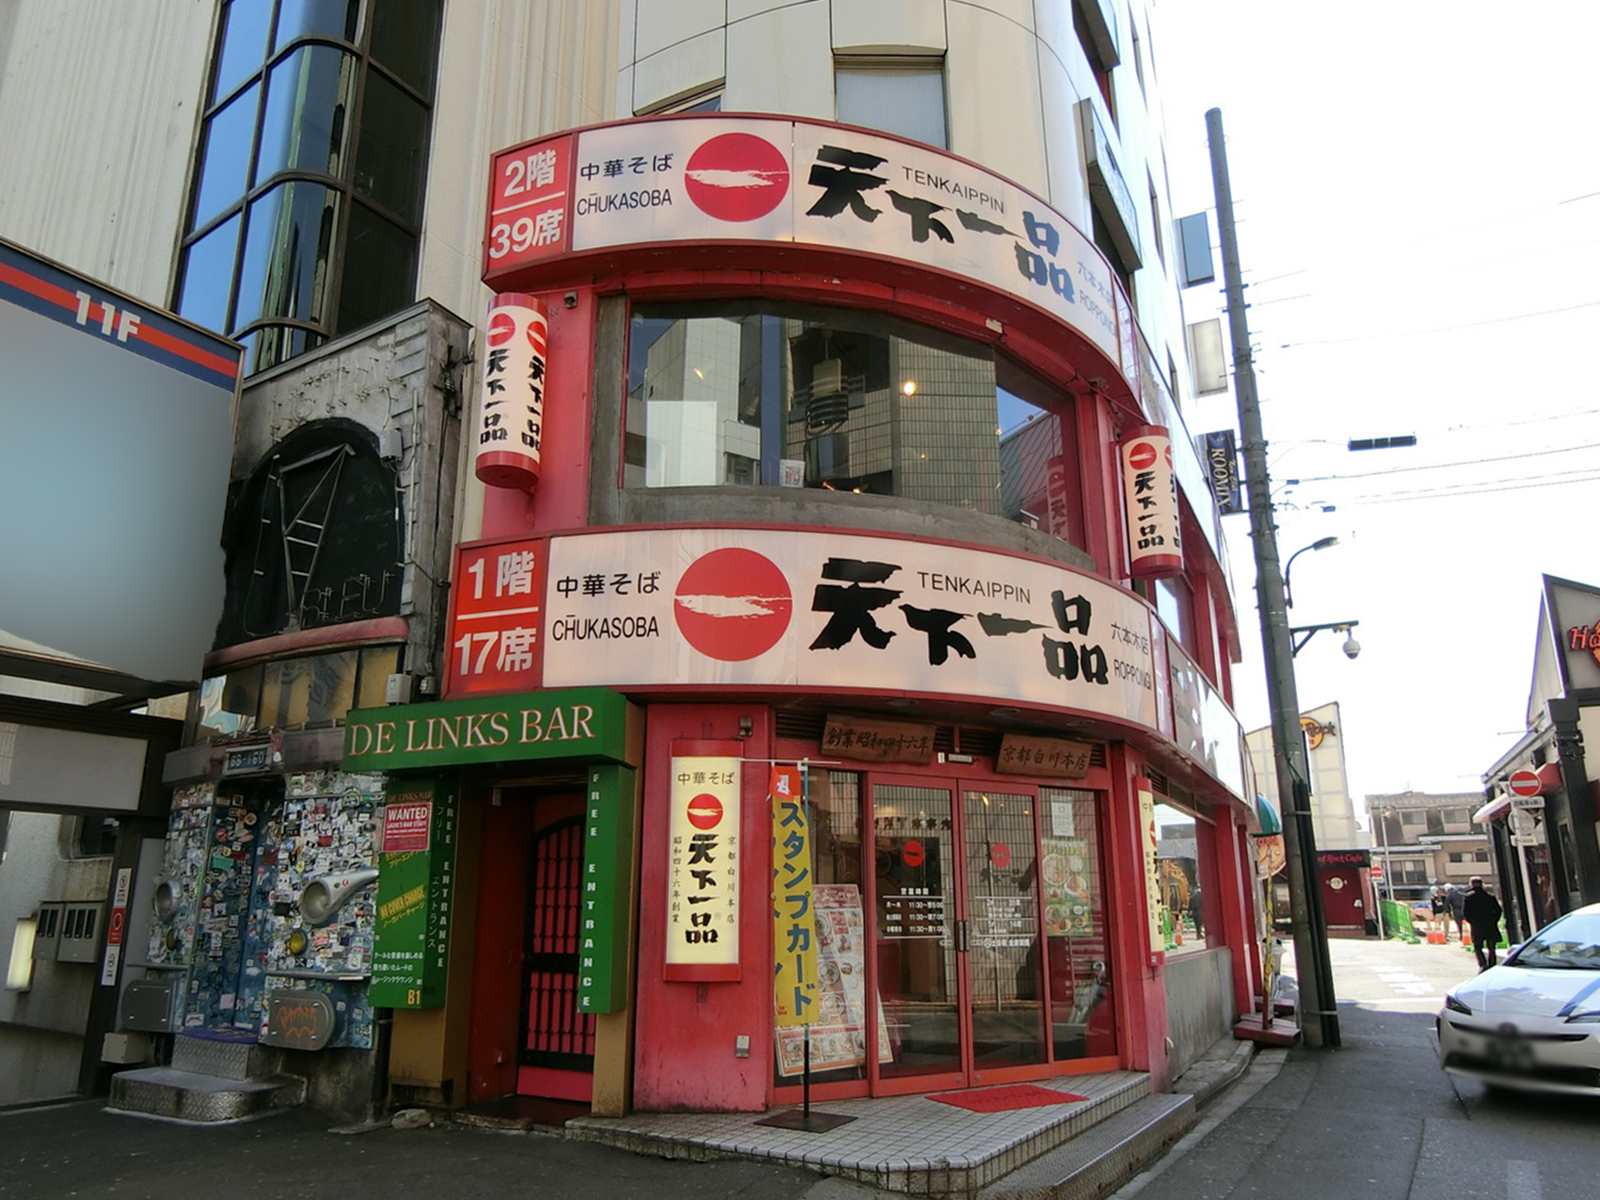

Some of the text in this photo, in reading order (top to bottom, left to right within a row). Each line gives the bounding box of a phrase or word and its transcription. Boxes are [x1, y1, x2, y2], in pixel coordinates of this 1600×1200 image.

[503, 149, 557, 198] 2階
[580, 153, 674, 181] 中華そば
[902, 165, 1005, 215] TENKAIPPIN
[489, 207, 564, 259] 39席
[805, 144, 1075, 305] 天下一品
[75, 290, 141, 342] 11F
[479, 348, 510, 445] 天下一品
[521, 355, 545, 452] 天下一品
[1134, 470, 1164, 550] 天下一品
[468, 550, 536, 599] 1階
[556, 571, 662, 598] 中華そば
[917, 571, 1032, 605] TENKAIPPIN
[808, 557, 1109, 685] 天下一品
[1110, 621, 1149, 656] 六本木店
[454, 626, 537, 676] 17席
[348, 704, 596, 756] DE LINKS BAR
[826, 727, 930, 755] 創業昭和四十六年
[677, 772, 734, 786] 中華そば
[1002, 745, 1087, 771] 京都白川本店
[388, 807, 427, 821] WANTED
[437, 795, 454, 968] FREE ENTRANCE
[582, 773, 600, 1007] FREE ENTRANCE
[671, 836, 683, 923] 昭和四十六年創業
[684, 833, 720, 944] 天下一品
[726, 836, 736, 924] 京都白川本店
[779, 802, 815, 1017] スタンプカード
[407, 989, 421, 1006] B1
